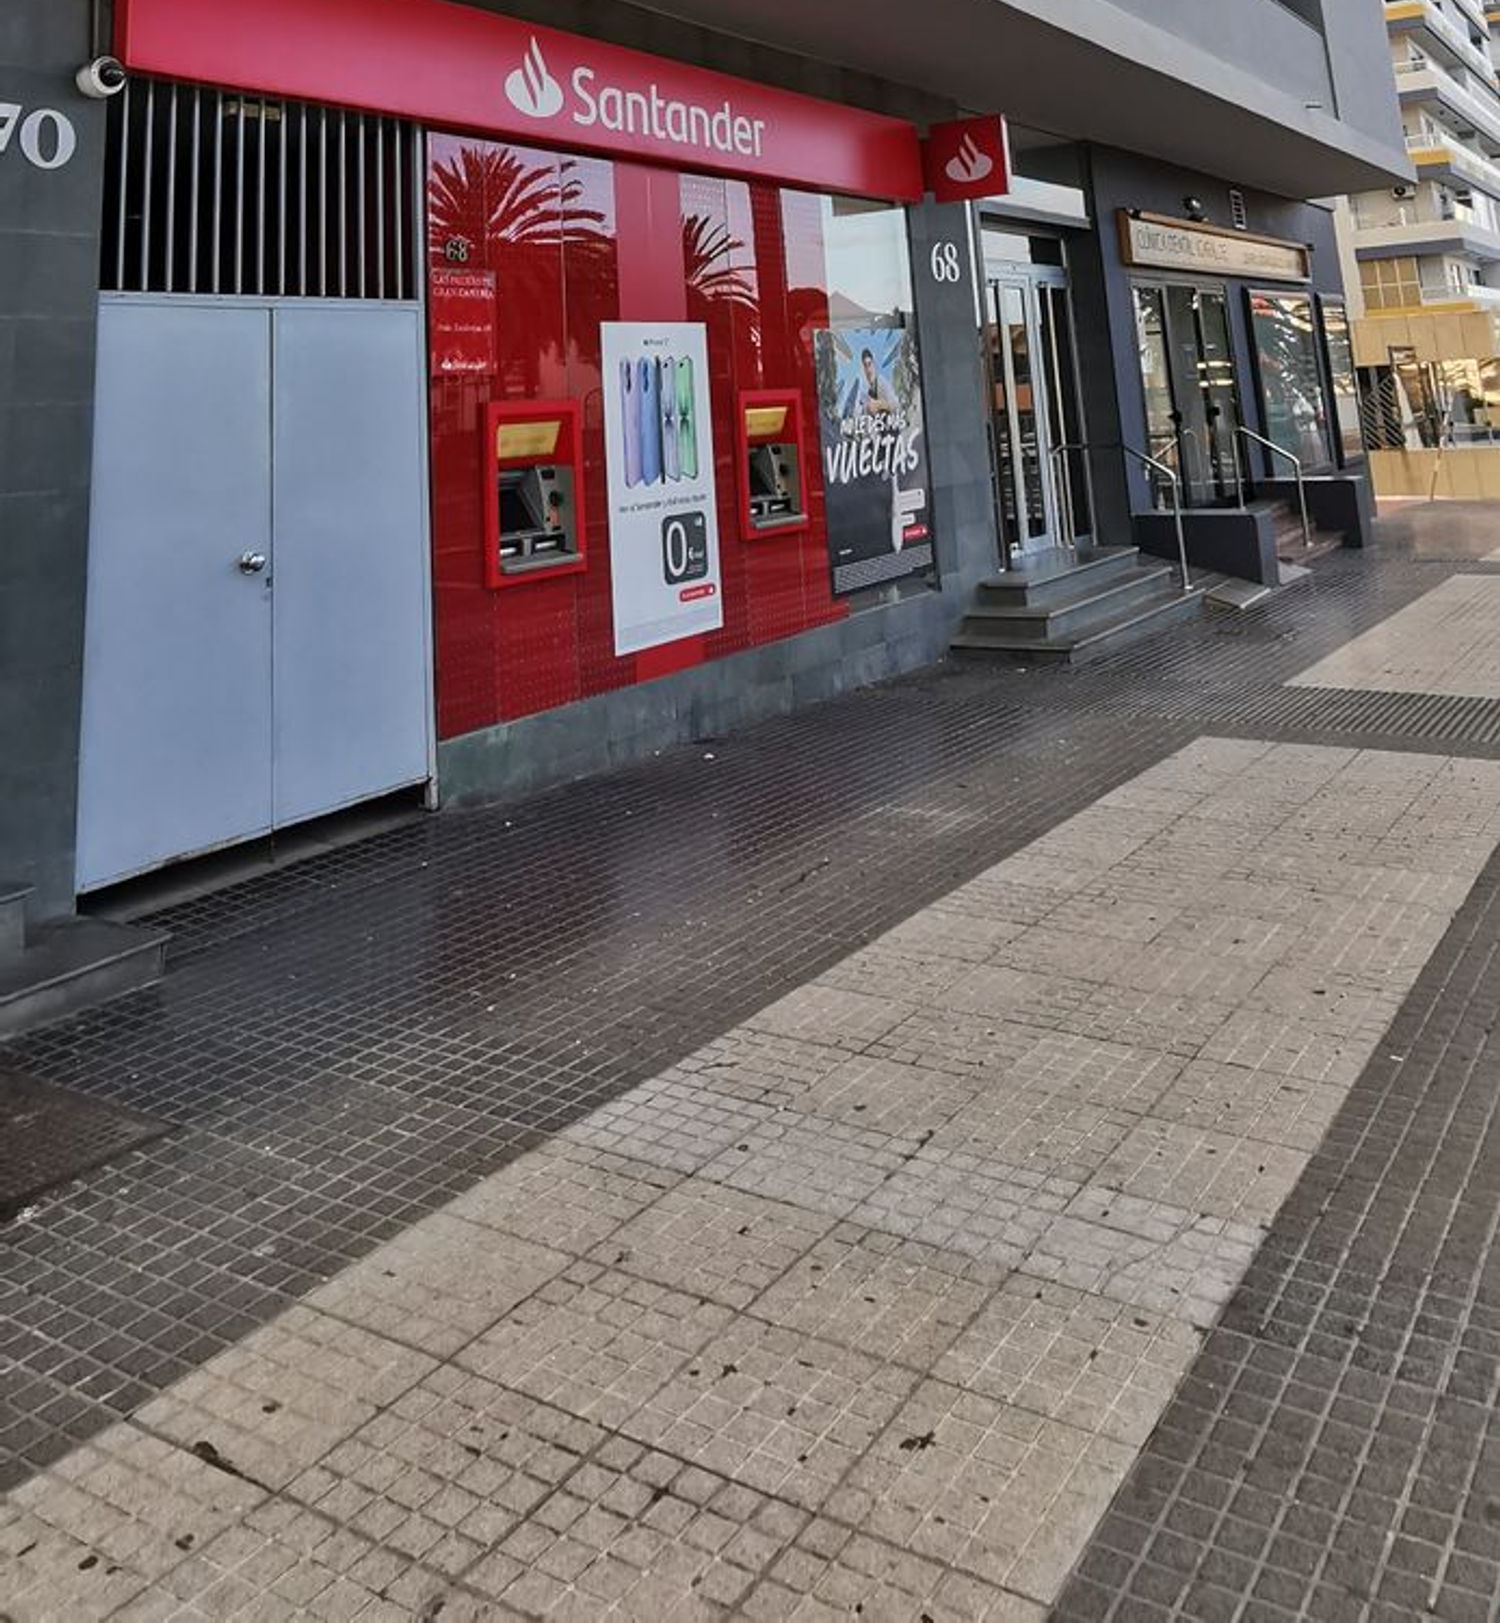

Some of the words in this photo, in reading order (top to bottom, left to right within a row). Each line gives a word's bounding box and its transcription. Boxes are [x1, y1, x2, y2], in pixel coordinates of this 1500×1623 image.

[572, 66, 765, 157] Santander
[445, 238, 468, 263] 68
[931, 242, 960, 282] 68
[826, 428, 920, 484] VUELTAS
[666, 521, 687, 577] 0
